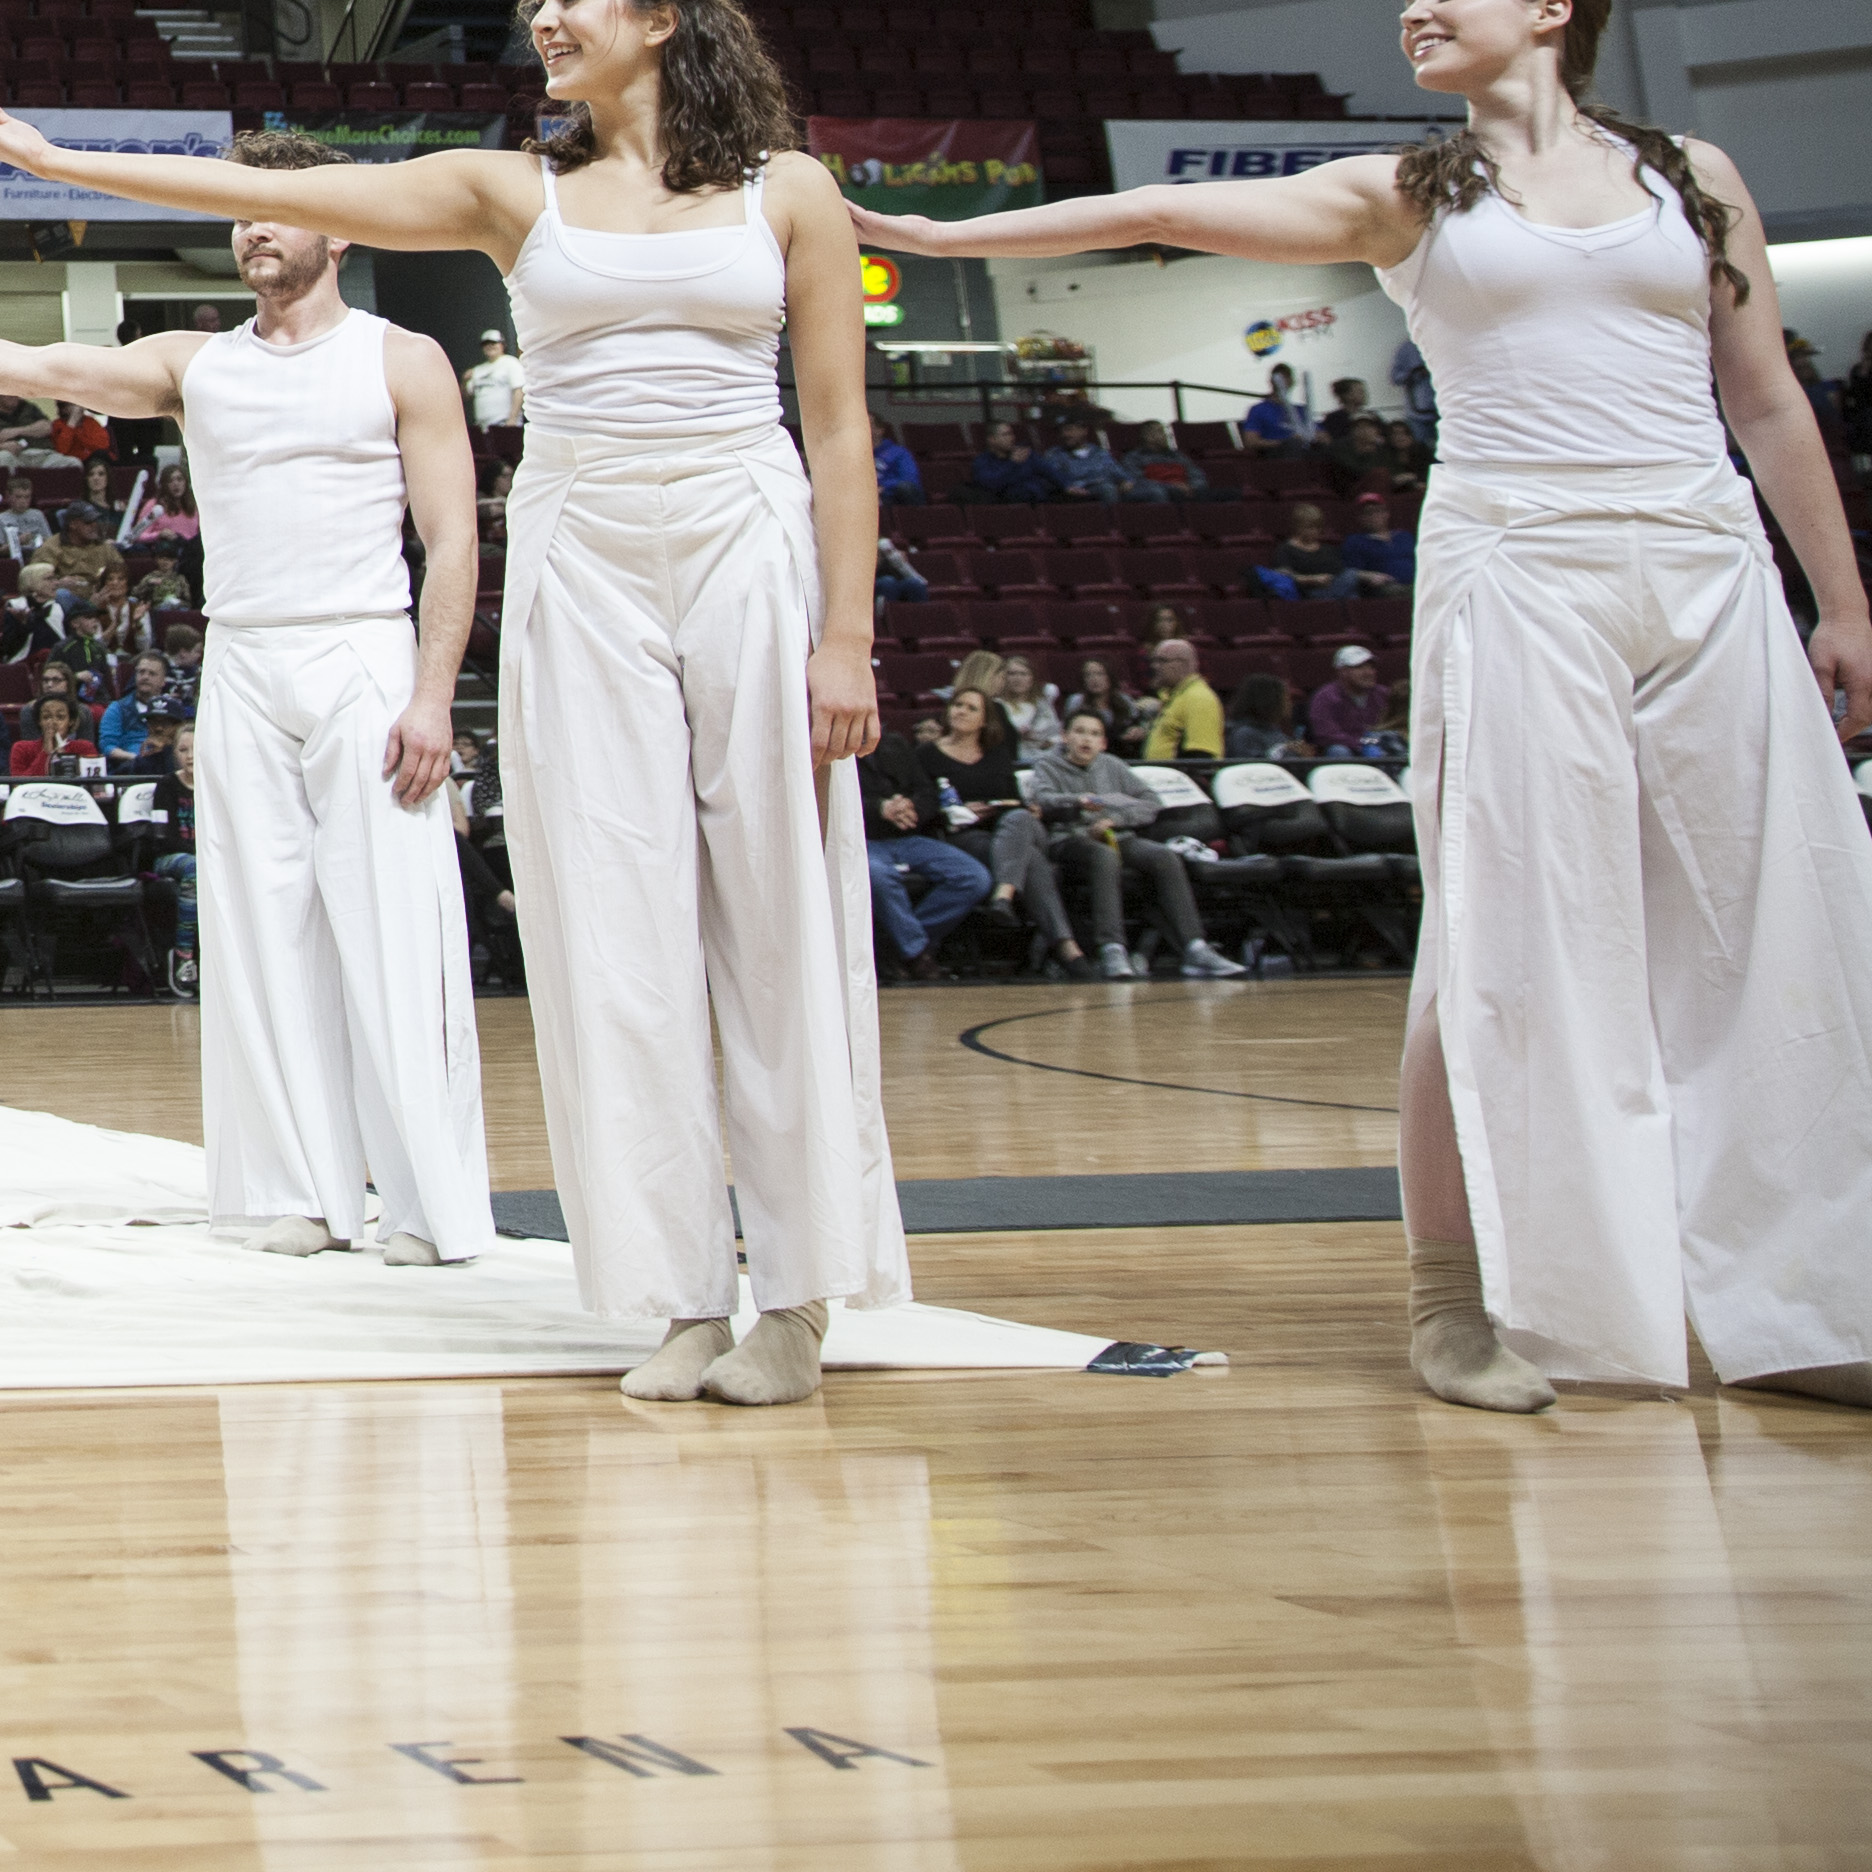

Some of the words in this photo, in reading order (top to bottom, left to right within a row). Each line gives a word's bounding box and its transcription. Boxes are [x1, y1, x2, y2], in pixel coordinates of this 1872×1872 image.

[1167, 149, 1376, 177] FIBE
[3, 187, 60, 200] Furniture
[12, 1723, 940, 1808] ARENA
